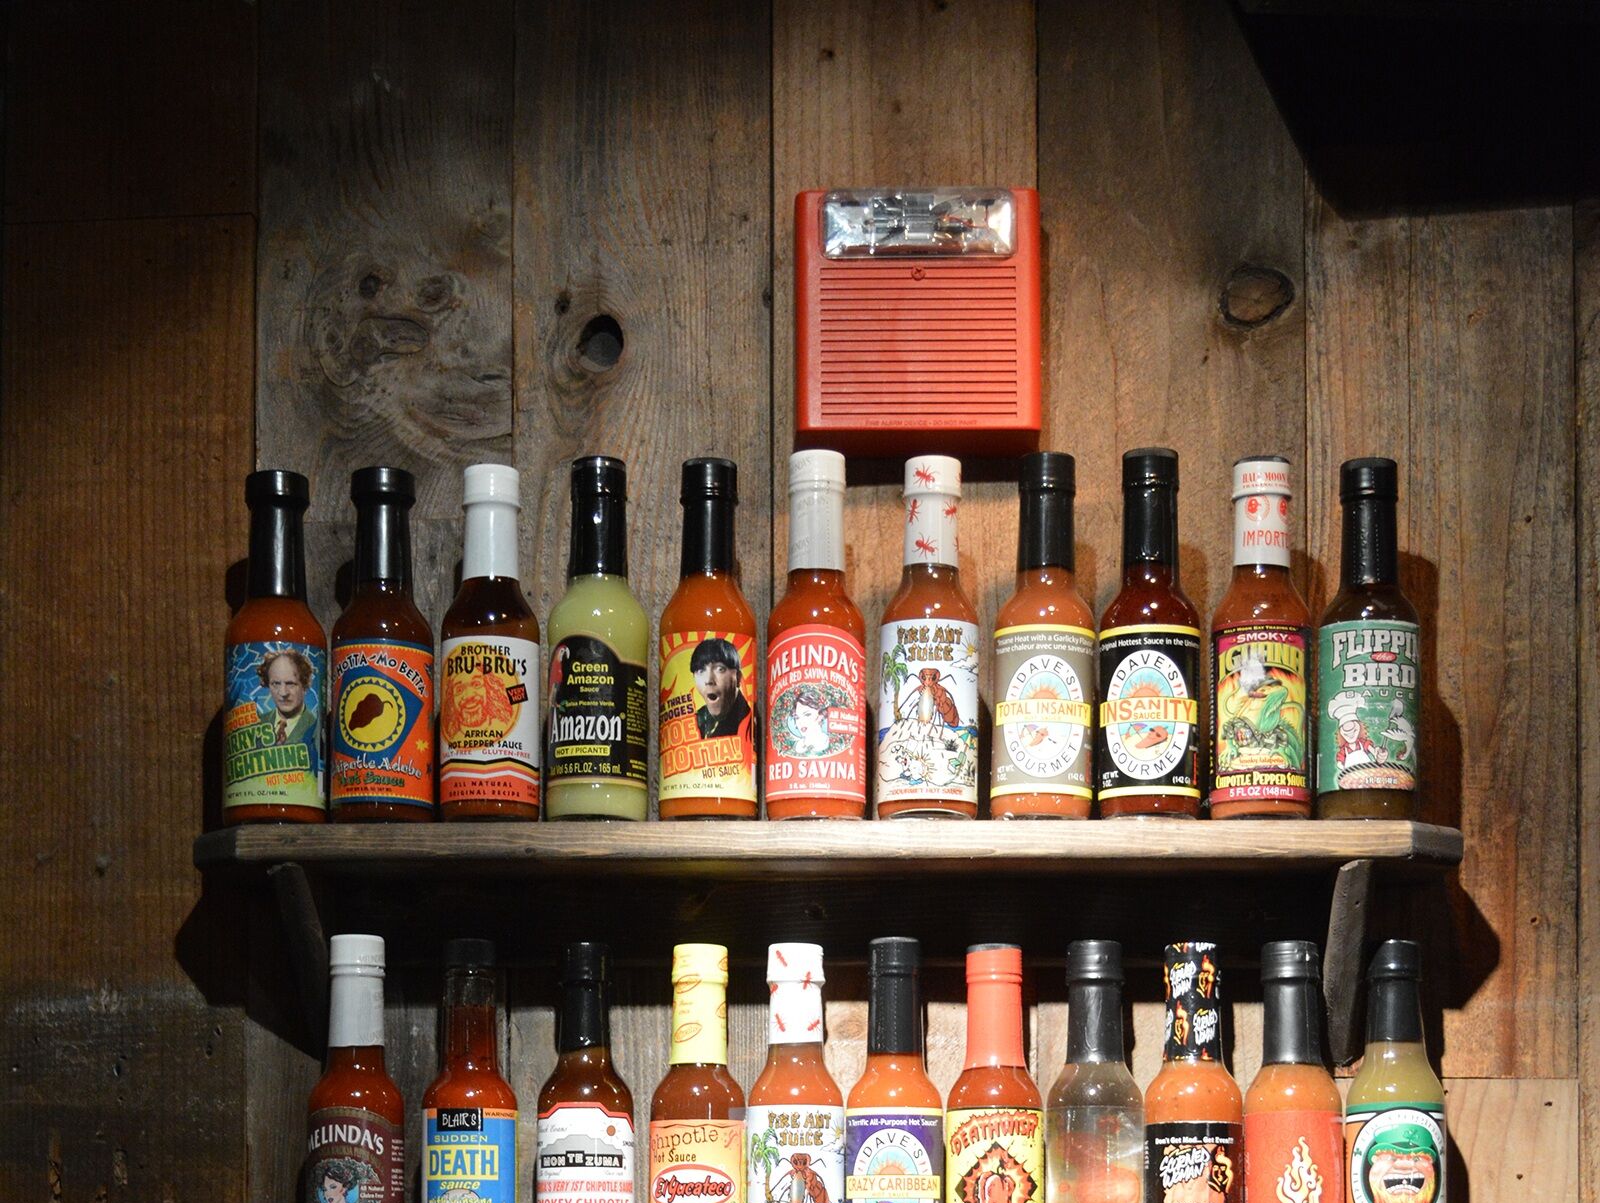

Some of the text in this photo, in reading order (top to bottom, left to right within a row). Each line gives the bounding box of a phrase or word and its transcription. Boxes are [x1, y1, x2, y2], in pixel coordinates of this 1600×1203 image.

[1144, 637, 1164, 645] Sauce
[1237, 632, 1289, 643] SMOKY
[461, 645, 510, 655] BROTHER
[448, 656, 527, 676] BRU-BRU'S
[572, 662, 608, 673] Green
[771, 644, 858, 687] MELINDA'S
[1017, 658, 1076, 686] DAVE'S
[1116, 653, 1179, 681] DAVE'S
[567, 675, 614, 685] Amazon
[790, 670, 802, 683] RED
[1343, 663, 1416, 687] BIRD
[508, 687, 525, 698] VERY
[999, 702, 1088, 720] TOTAL INSANITY
[1101, 698, 1194, 722] INSANITY
[1133, 712, 1161, 720] SAUCE
[551, 708, 621, 743] Amazon
[465, 730, 503, 739] AFRICAN
[449, 740, 522, 750] HOT PEPPER SAUCE
[482, 750, 530, 759] GLUTEN-FREE
[662, 737, 744, 777] HOTTA!
[1010, 740, 1077, 773] GOURMET
[1111, 741, 1182, 775] GOURMET
[702, 764, 740, 778] HOT SAUCE
[769, 764, 792, 780] RED
[800, 762, 856, 780] SAVINA
[266, 772, 304, 786] HOT SAUCE
[1215, 772, 1287, 788] CHIPOTLE PEPPER
[1247, 787, 1259, 795] OZ
[442, 1112, 477, 1127] BLAIR'S
[863, 1133, 924, 1159] DAVE'S
[430, 1150, 495, 1175] DEATH
[668, 1150, 696, 1162] Sauce
[1160, 1147, 1210, 1173] SCORNED
[1160, 1164, 1204, 1189] WOMAN
[440, 1182, 480, 1190] sauce
[586, 1182, 617, 1191] CHIPOTLE
[878, 1178, 937, 1191] CARIBBEAN
